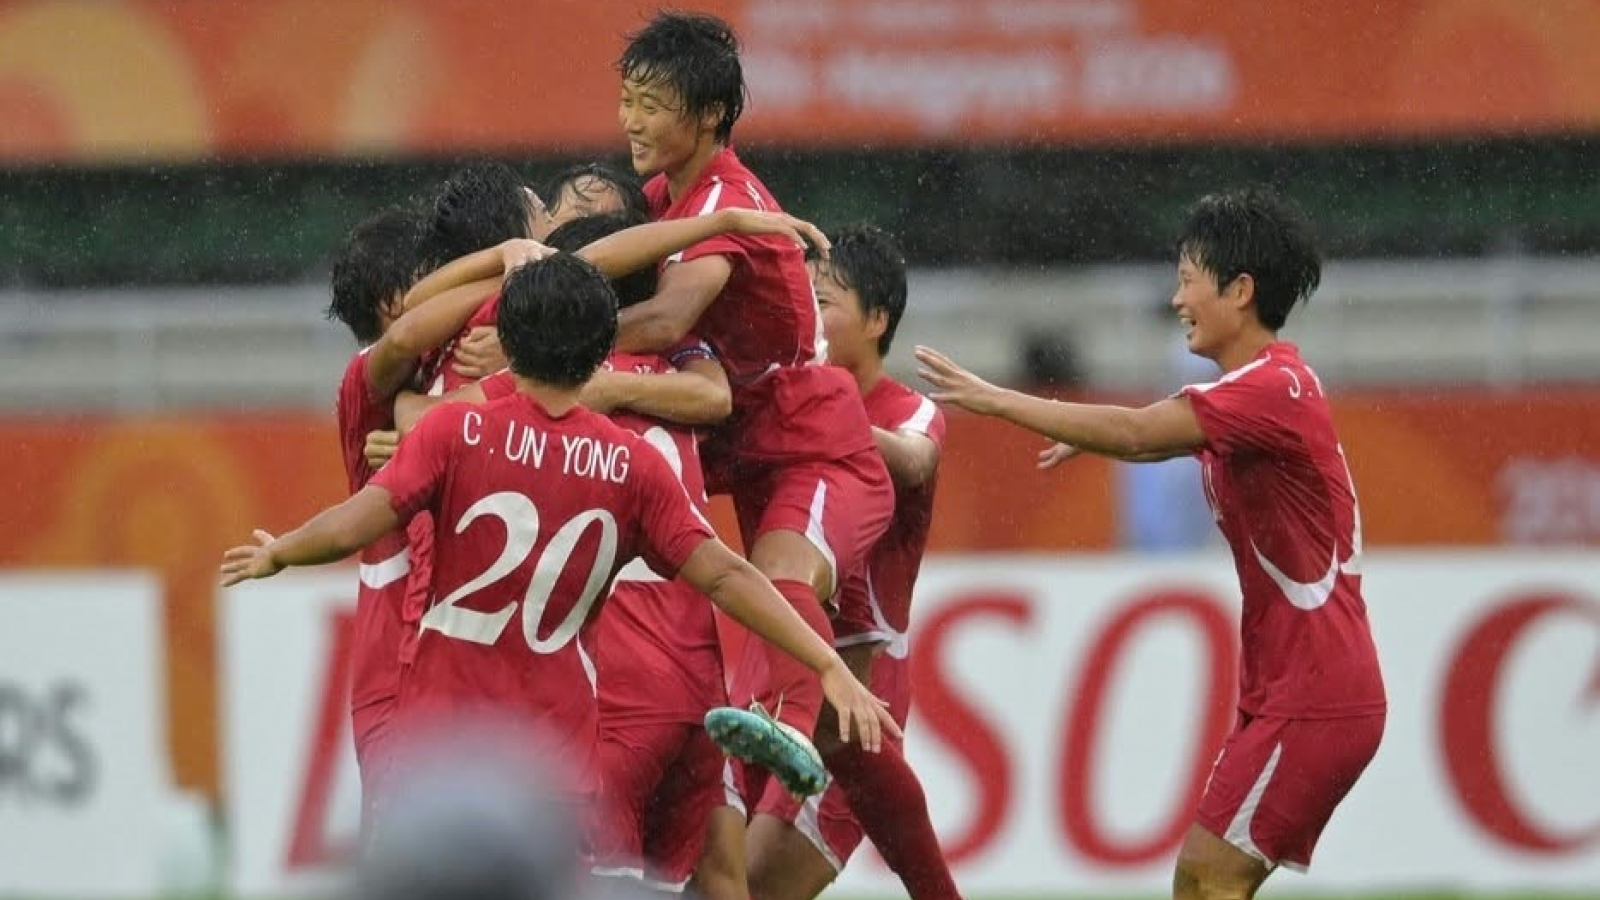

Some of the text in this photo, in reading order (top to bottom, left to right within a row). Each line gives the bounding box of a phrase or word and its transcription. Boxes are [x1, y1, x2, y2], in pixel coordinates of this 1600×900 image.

[505, 420, 547, 469] UN
[562, 435, 630, 483] YONG
[417, 490, 618, 654] 20
